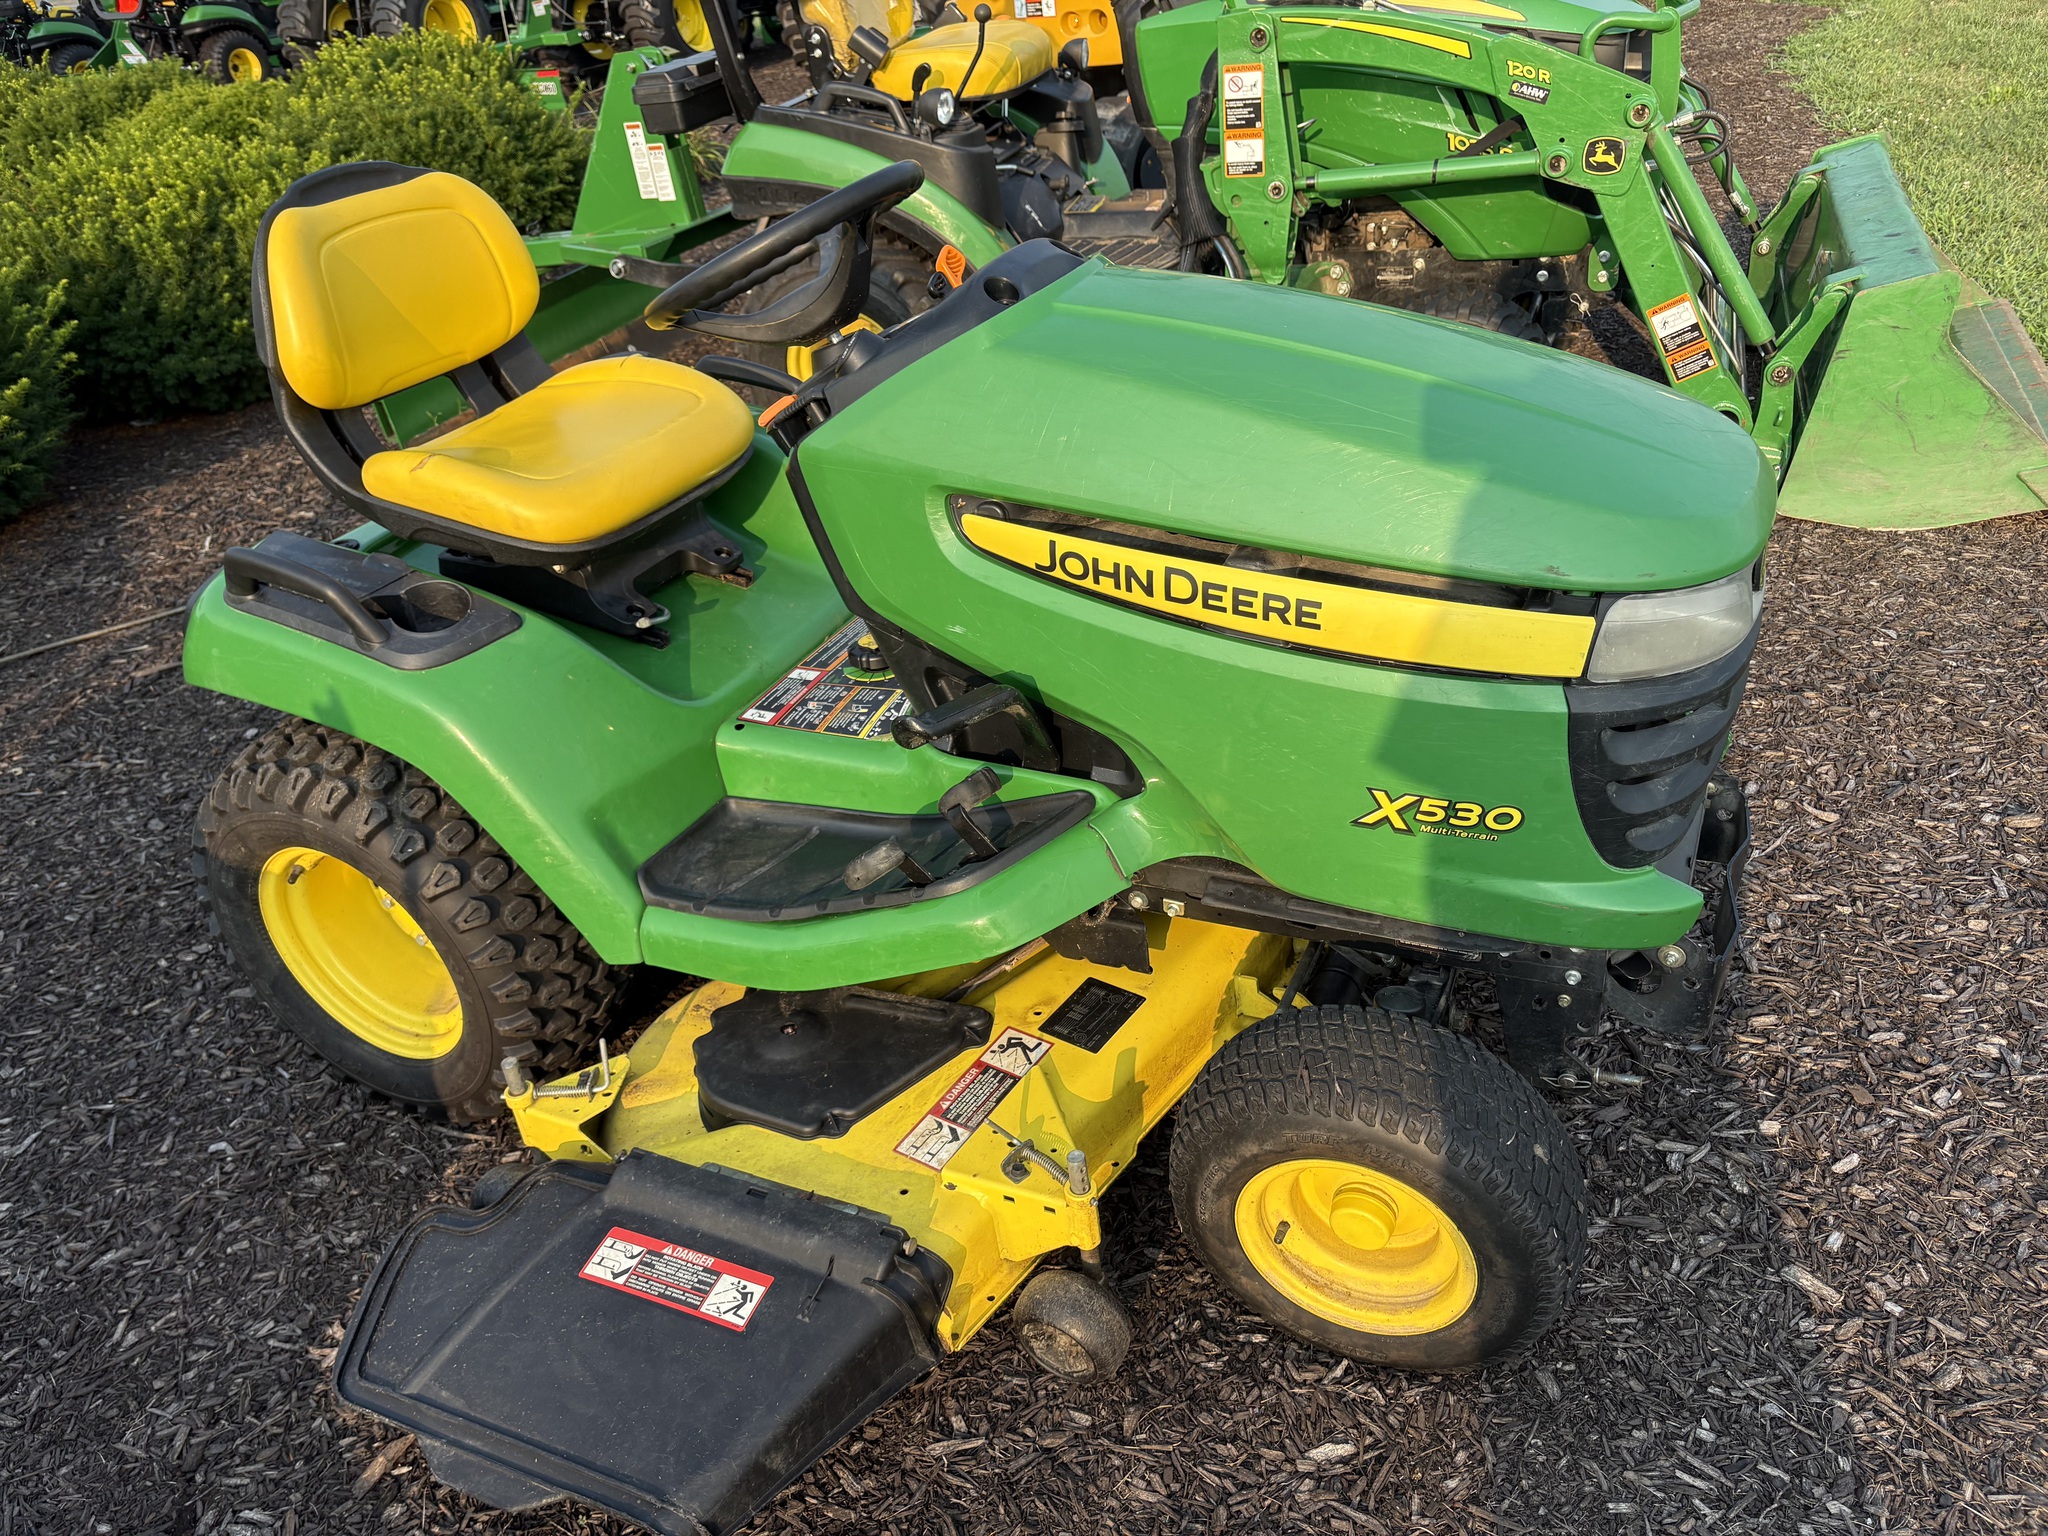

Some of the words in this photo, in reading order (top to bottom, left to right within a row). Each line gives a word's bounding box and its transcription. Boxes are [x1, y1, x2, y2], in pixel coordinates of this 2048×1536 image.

[1230, 64, 1262, 72] WARNING
[1506, 59, 1537, 80] 120
[1538, 68, 1551, 85] R
[1231, 132, 1262, 140] WARNING
[1658, 297, 1685, 312] WARNING
[1035, 539, 1154, 598] JOHN
[1164, 566, 1322, 630] DEERE
[1350, 786, 1525, 837] X530
[1419, 824, 1498, 842] Multi-Terrain
[945, 1067, 979, 1100] DANGER
[672, 1247, 714, 1267] DANGER
